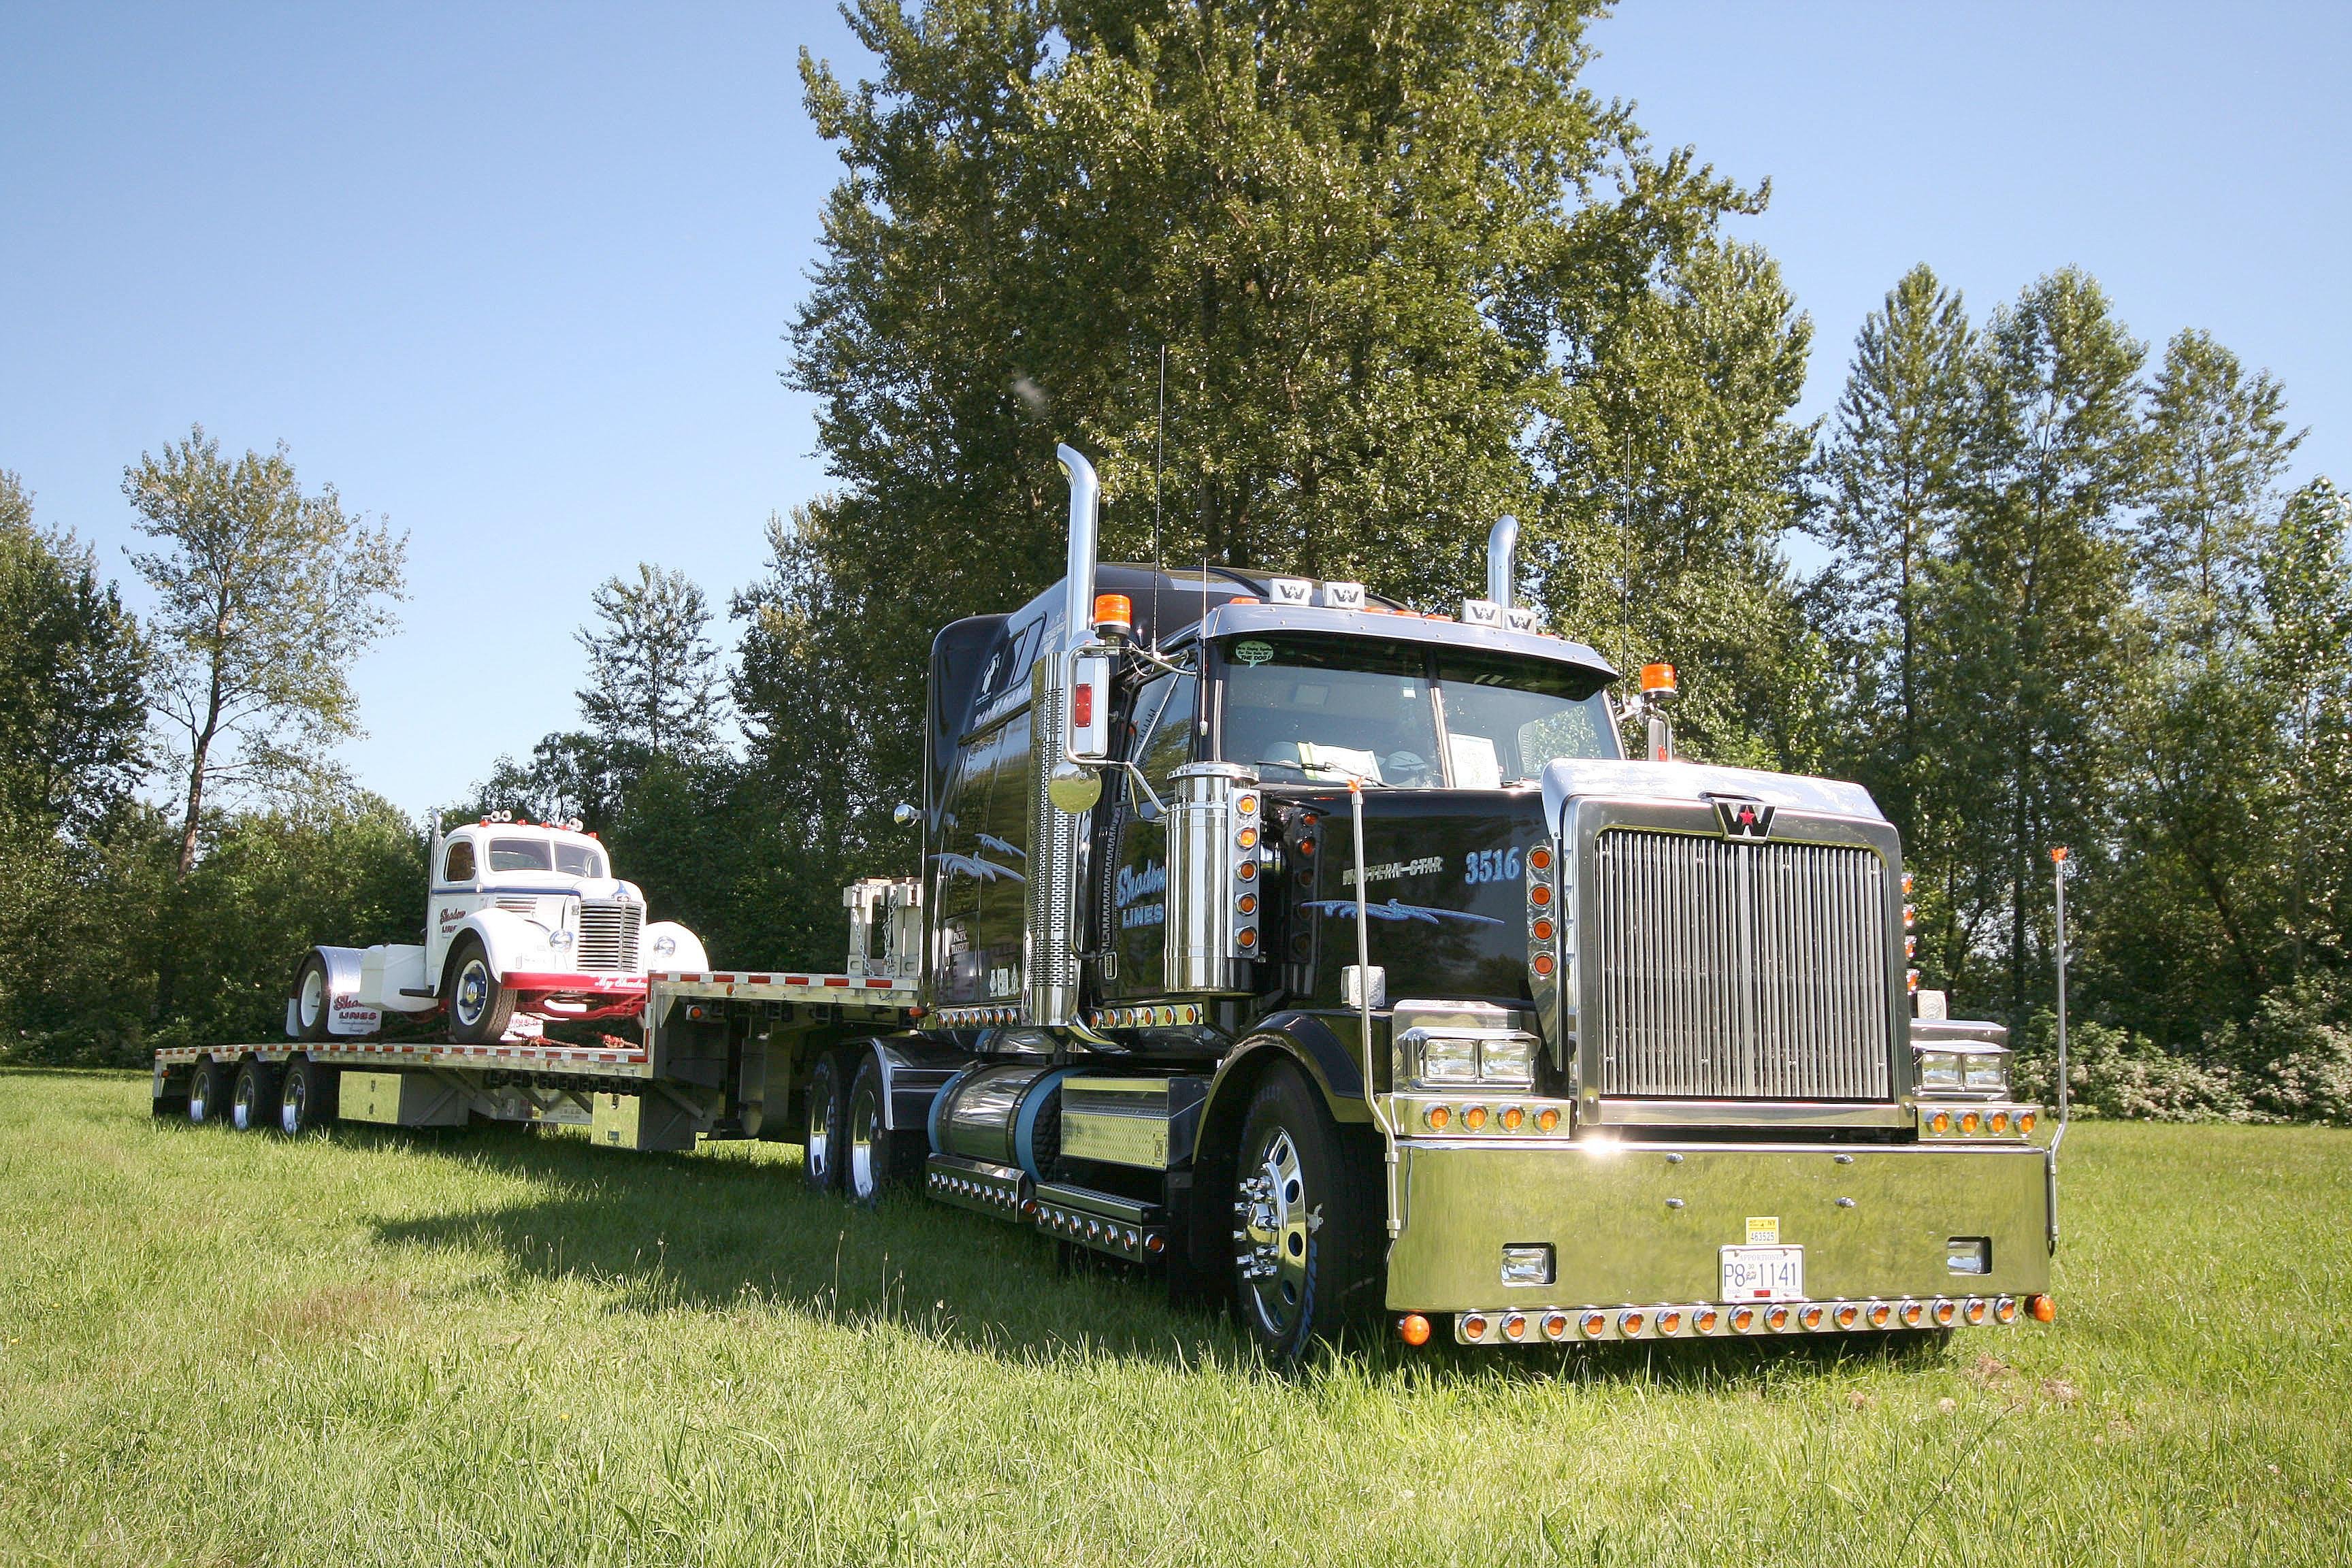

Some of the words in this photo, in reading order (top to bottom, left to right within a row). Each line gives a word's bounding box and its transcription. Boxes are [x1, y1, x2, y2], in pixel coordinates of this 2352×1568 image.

[1343, 862, 1403, 885] WSTERN
[1409, 856, 1443, 877] STAR
[1464, 847, 1520, 885] 3516
[440, 908, 466, 925] Shadow
[1122, 903, 1164, 929] LINES
[595, 977, 614, 990] My
[615, 976, 648, 988] Shado
[339, 1012, 377, 1020] LINES
